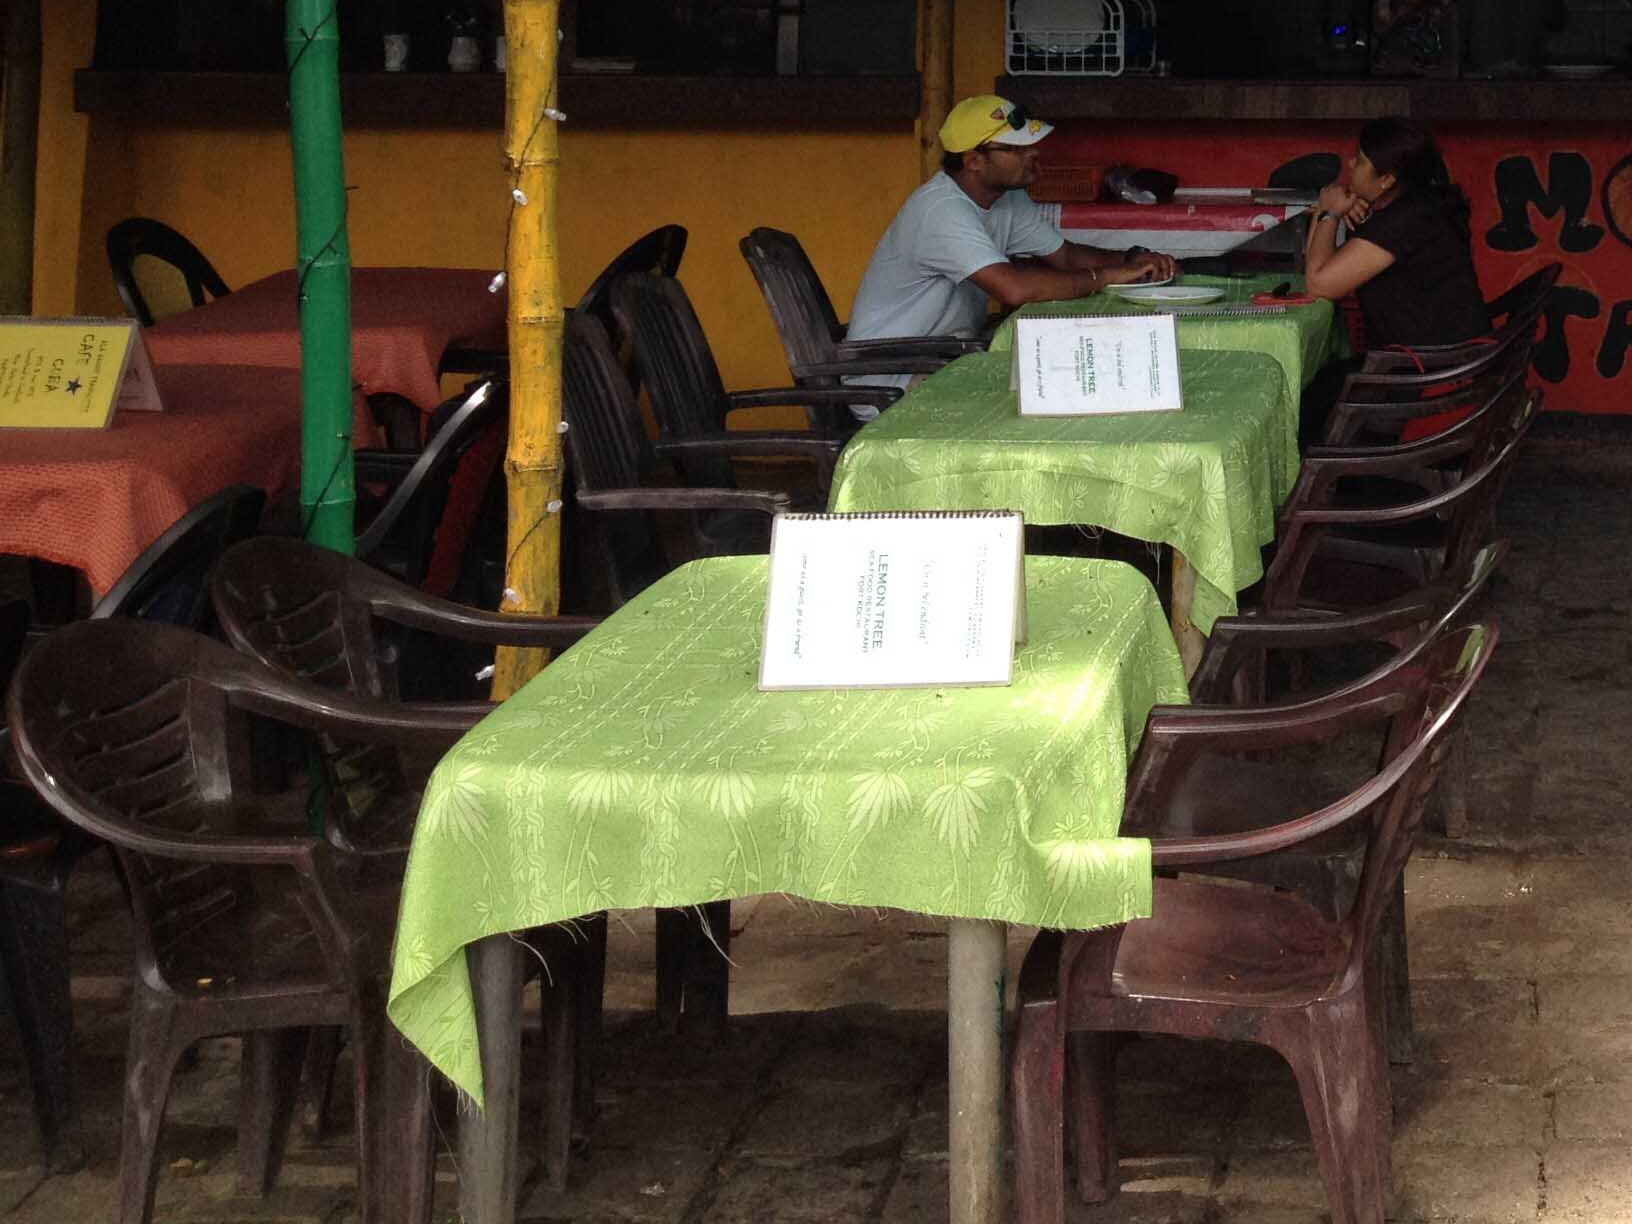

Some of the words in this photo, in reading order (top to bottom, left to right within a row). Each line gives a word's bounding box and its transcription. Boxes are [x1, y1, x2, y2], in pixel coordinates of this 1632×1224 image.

[1085, 338, 1095, 369] LEMON
[1087, 371, 1096, 394] TREE
[874, 553, 889, 608] LEMON
[872, 609, 886, 649] TREE
